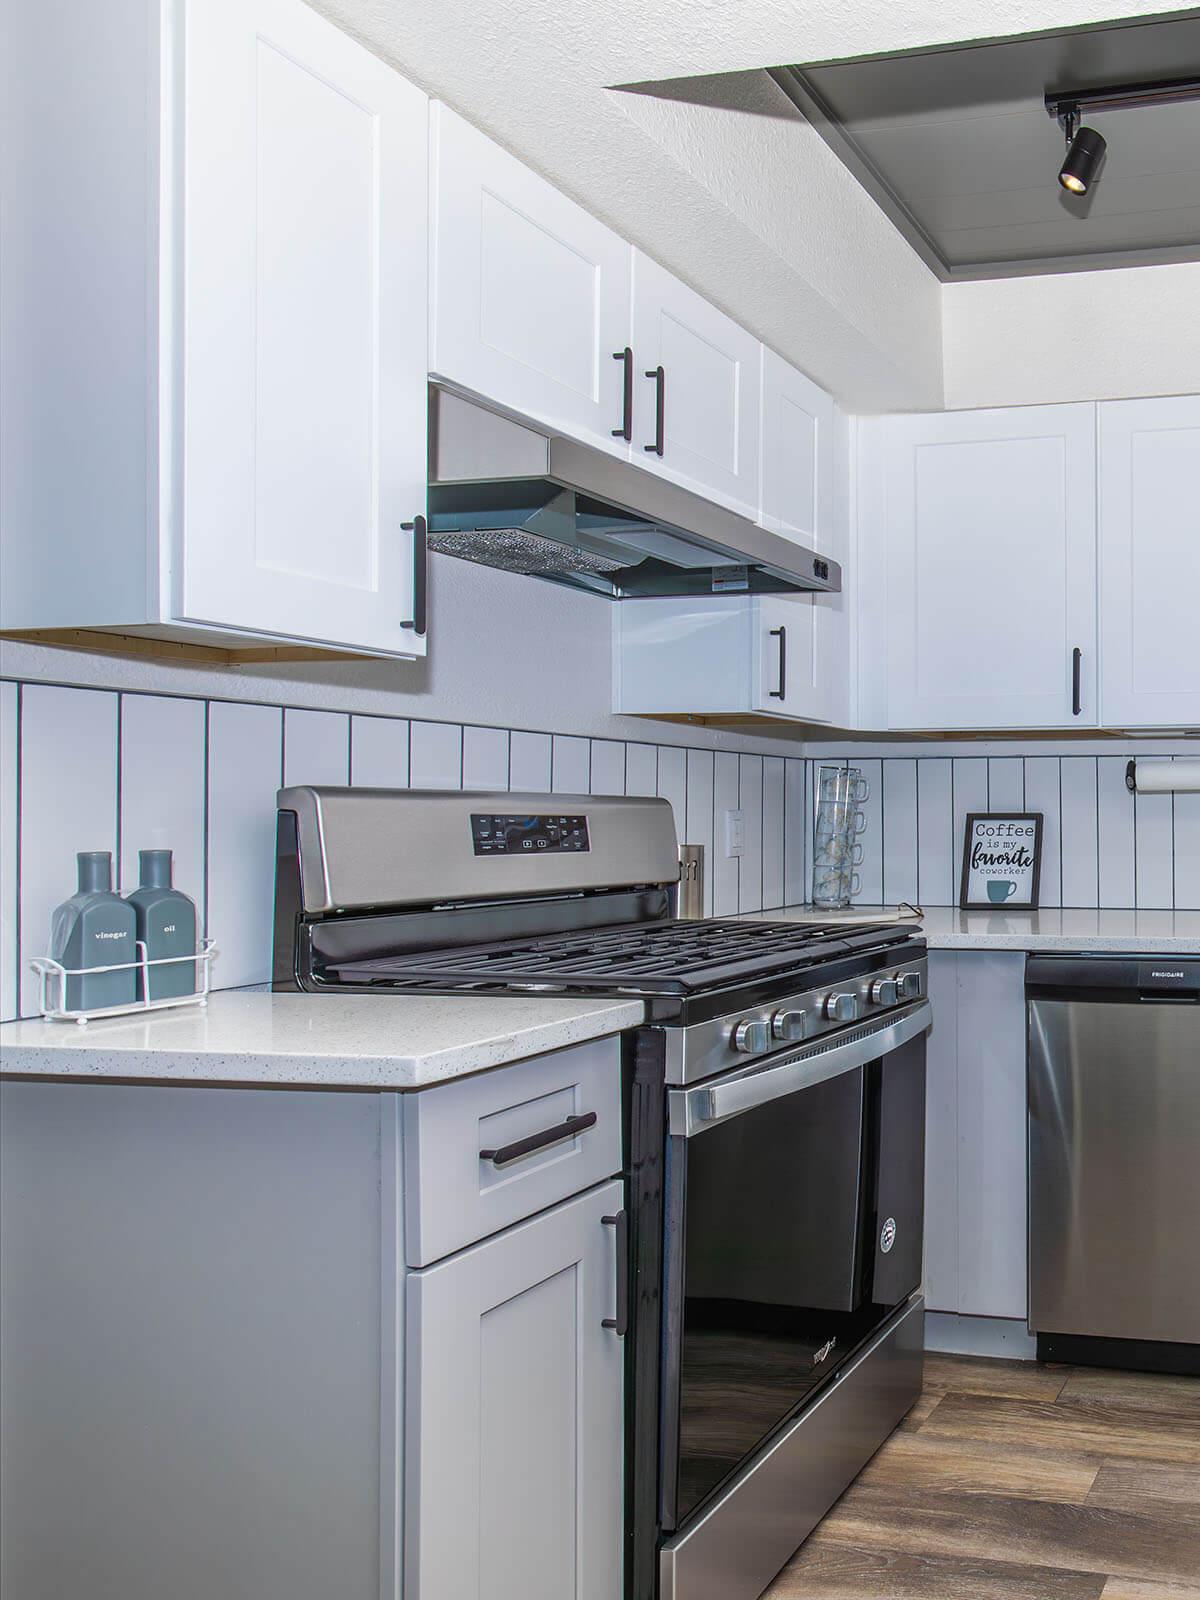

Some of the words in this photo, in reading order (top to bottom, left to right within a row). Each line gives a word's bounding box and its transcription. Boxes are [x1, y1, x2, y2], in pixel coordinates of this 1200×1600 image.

[976, 824, 1034, 837] Coffee
[987, 839, 1000, 848] is
[1003, 841, 1017, 850] my
[972, 842, 1035, 870] favorite
[980, 867, 1026, 875] coworker
[163, 925, 176, 933] oil
[95, 931, 128, 939] vinegar
